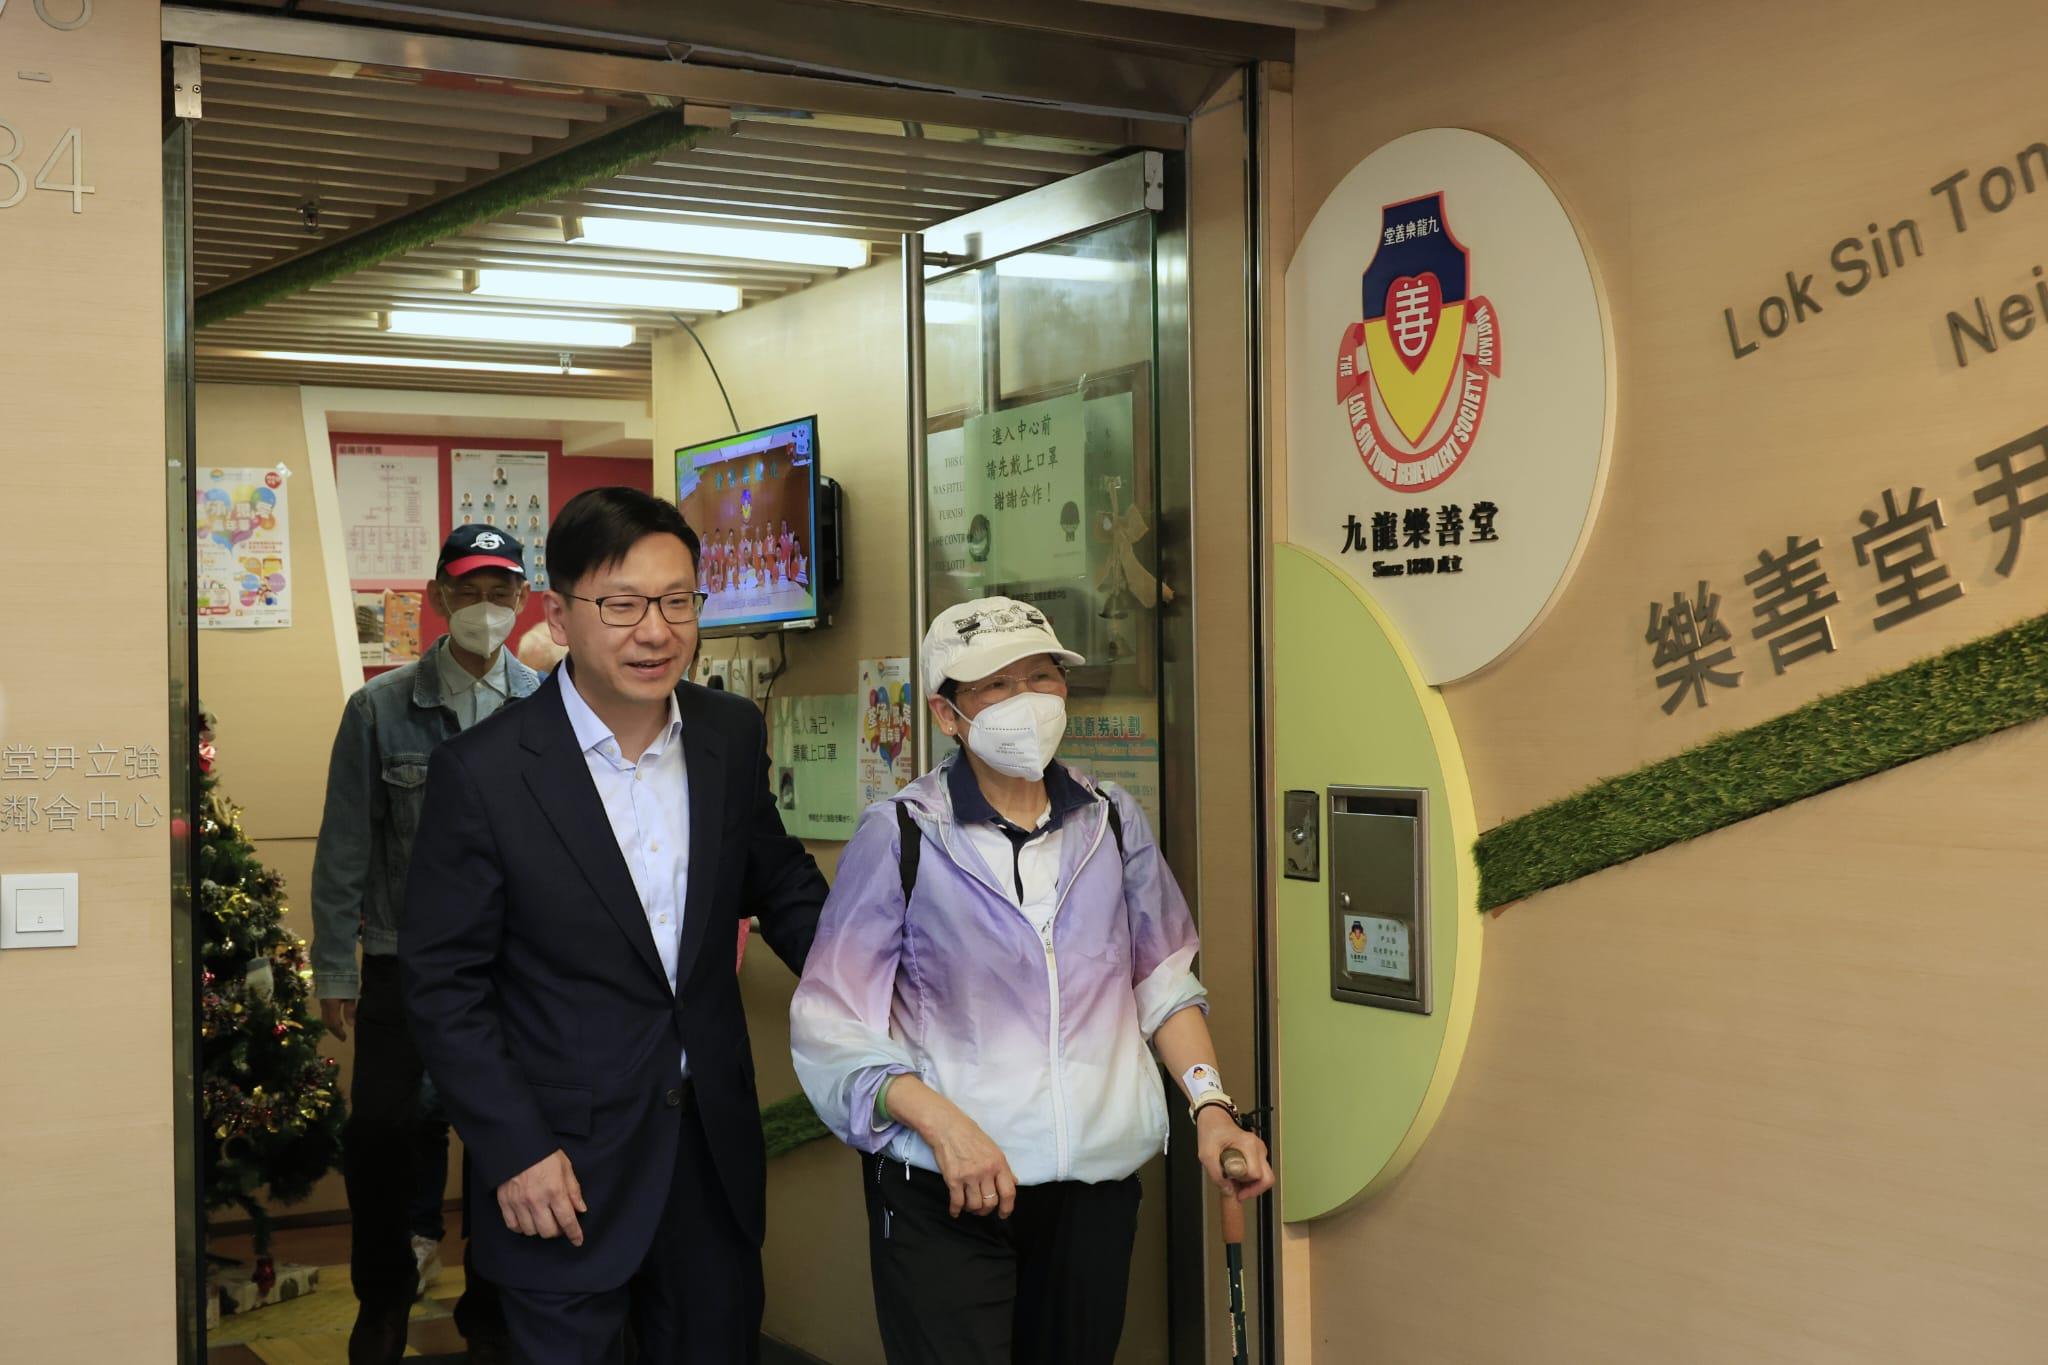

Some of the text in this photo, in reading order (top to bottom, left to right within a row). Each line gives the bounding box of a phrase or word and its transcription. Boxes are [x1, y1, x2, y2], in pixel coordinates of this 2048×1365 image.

[1724, 142, 2048, 360] Lok Sin Ton
[1475, 305, 1493, 366] KOWLOON
[1348, 392, 1368, 427] LOK
[1453, 371, 1484, 442] SOCIETY
[991, 414, 1052, 445] 進入中心前
[1356, 423, 1377, 456] SIN
[985, 446, 1059, 480] 請先戴上口罩
[1341, 501, 1499, 554] 九龍樂善堂
[1, 743, 161, 781] 堂尹立強
[0, 792, 164, 832] 鄰舍中心
